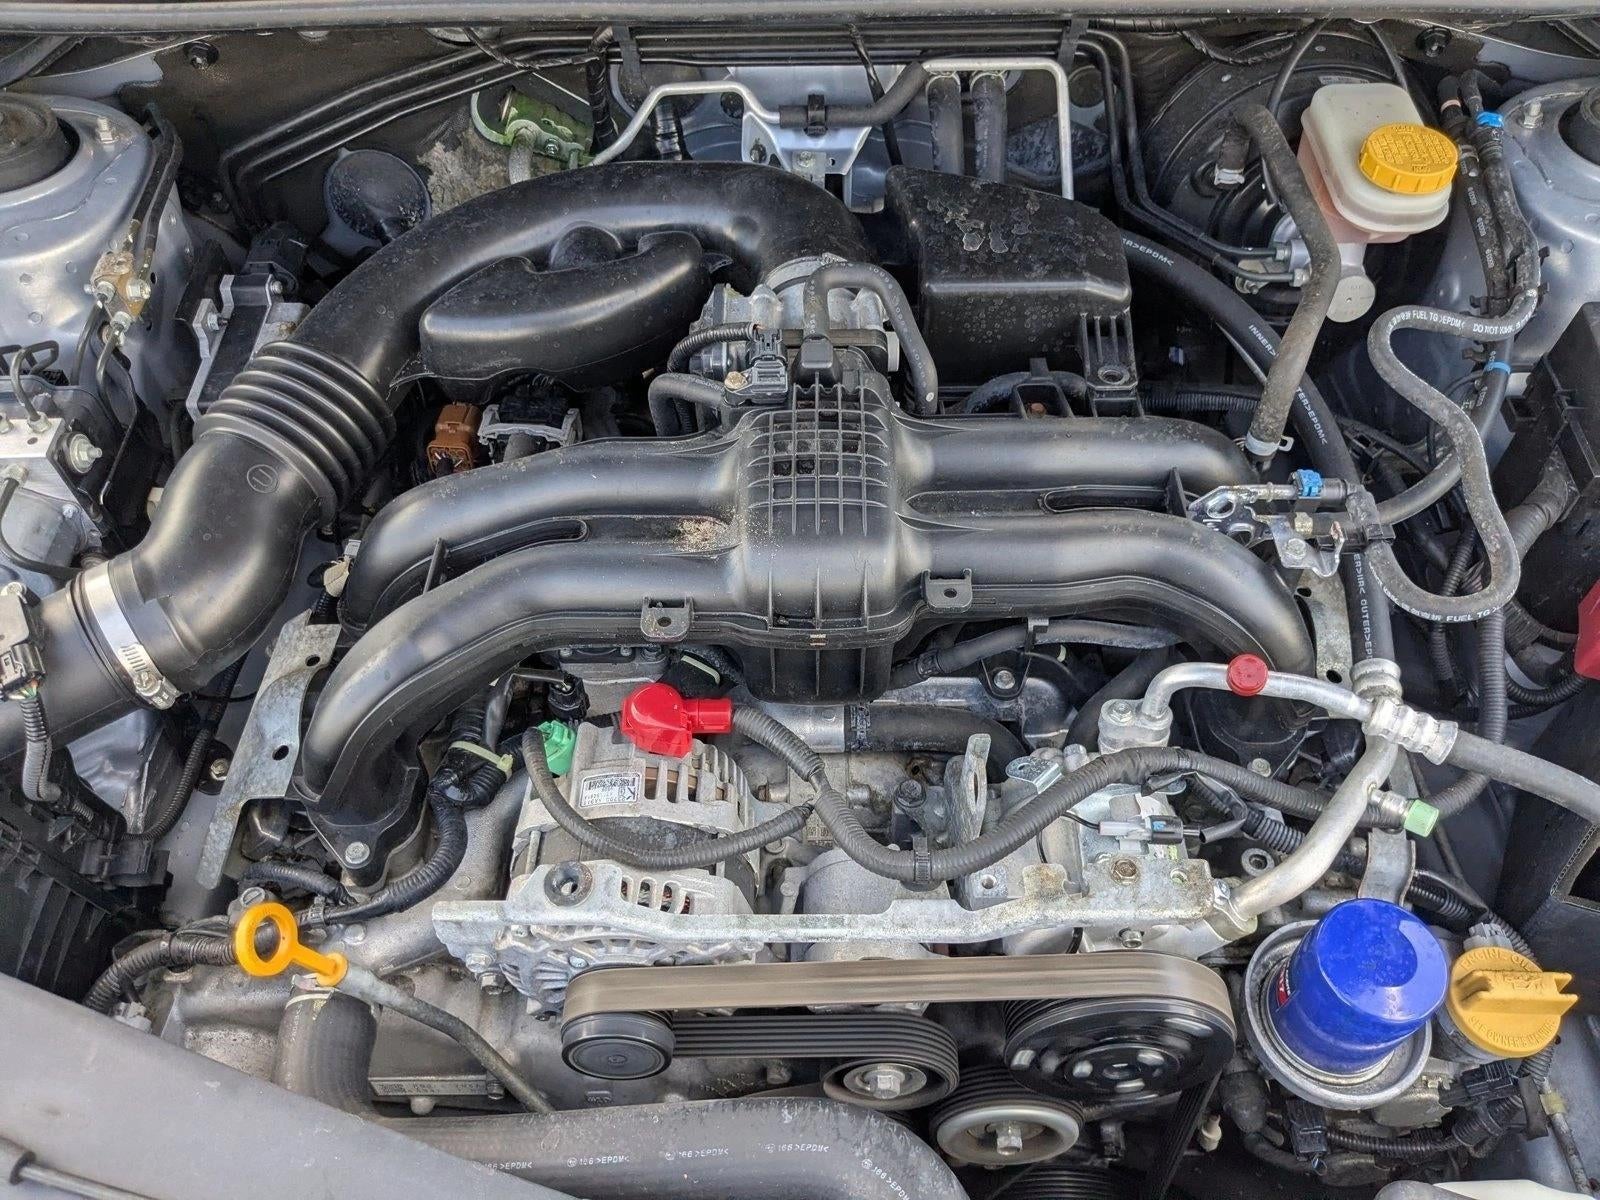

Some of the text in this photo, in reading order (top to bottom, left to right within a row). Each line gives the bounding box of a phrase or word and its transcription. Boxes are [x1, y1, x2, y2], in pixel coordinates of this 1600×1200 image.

[1412, 310, 1428, 320] FUEL
[1472, 323, 1484, 333] DO
[1484, 325, 1498, 335] NOT
